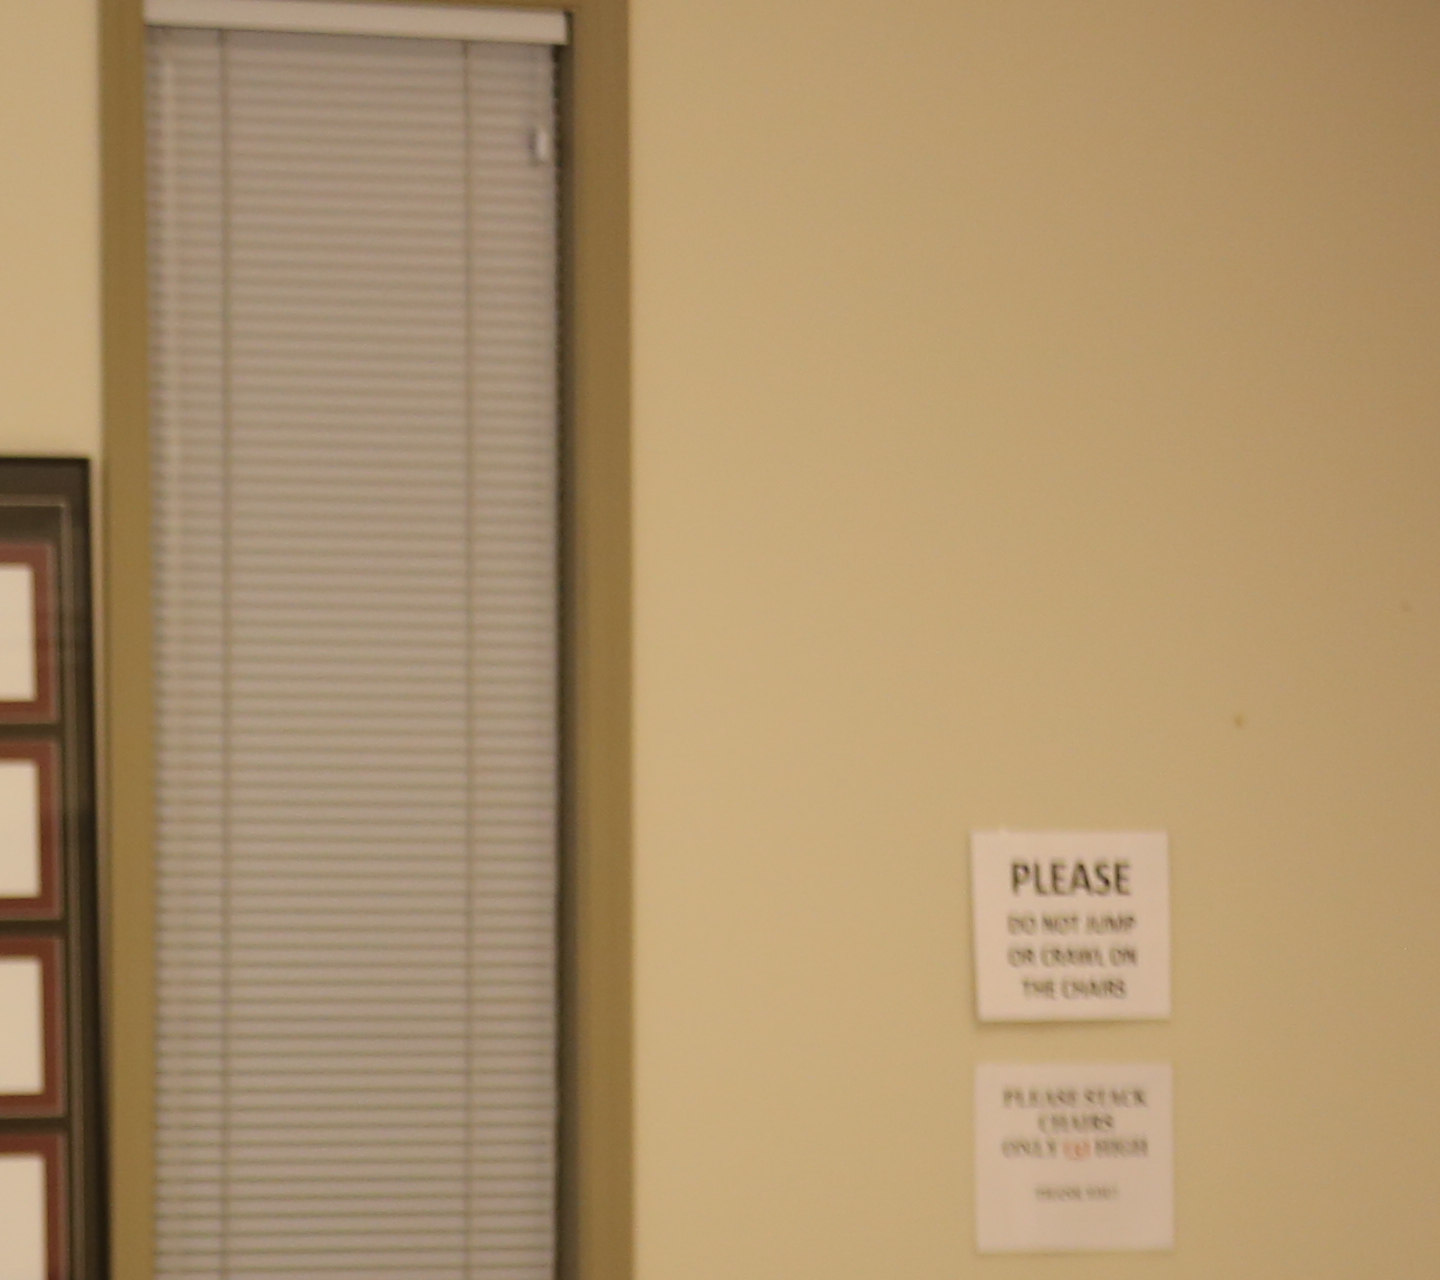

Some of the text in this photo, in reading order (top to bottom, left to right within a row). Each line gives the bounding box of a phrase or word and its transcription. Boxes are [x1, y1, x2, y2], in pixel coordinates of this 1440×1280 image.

[1011, 859, 1131, 896] PLEASE
[1007, 912, 1136, 934] DO NOT JUMP
[1007, 946, 1137, 967] OR CRAWL ON
[1022, 978, 1127, 999] THE CHAIRS
